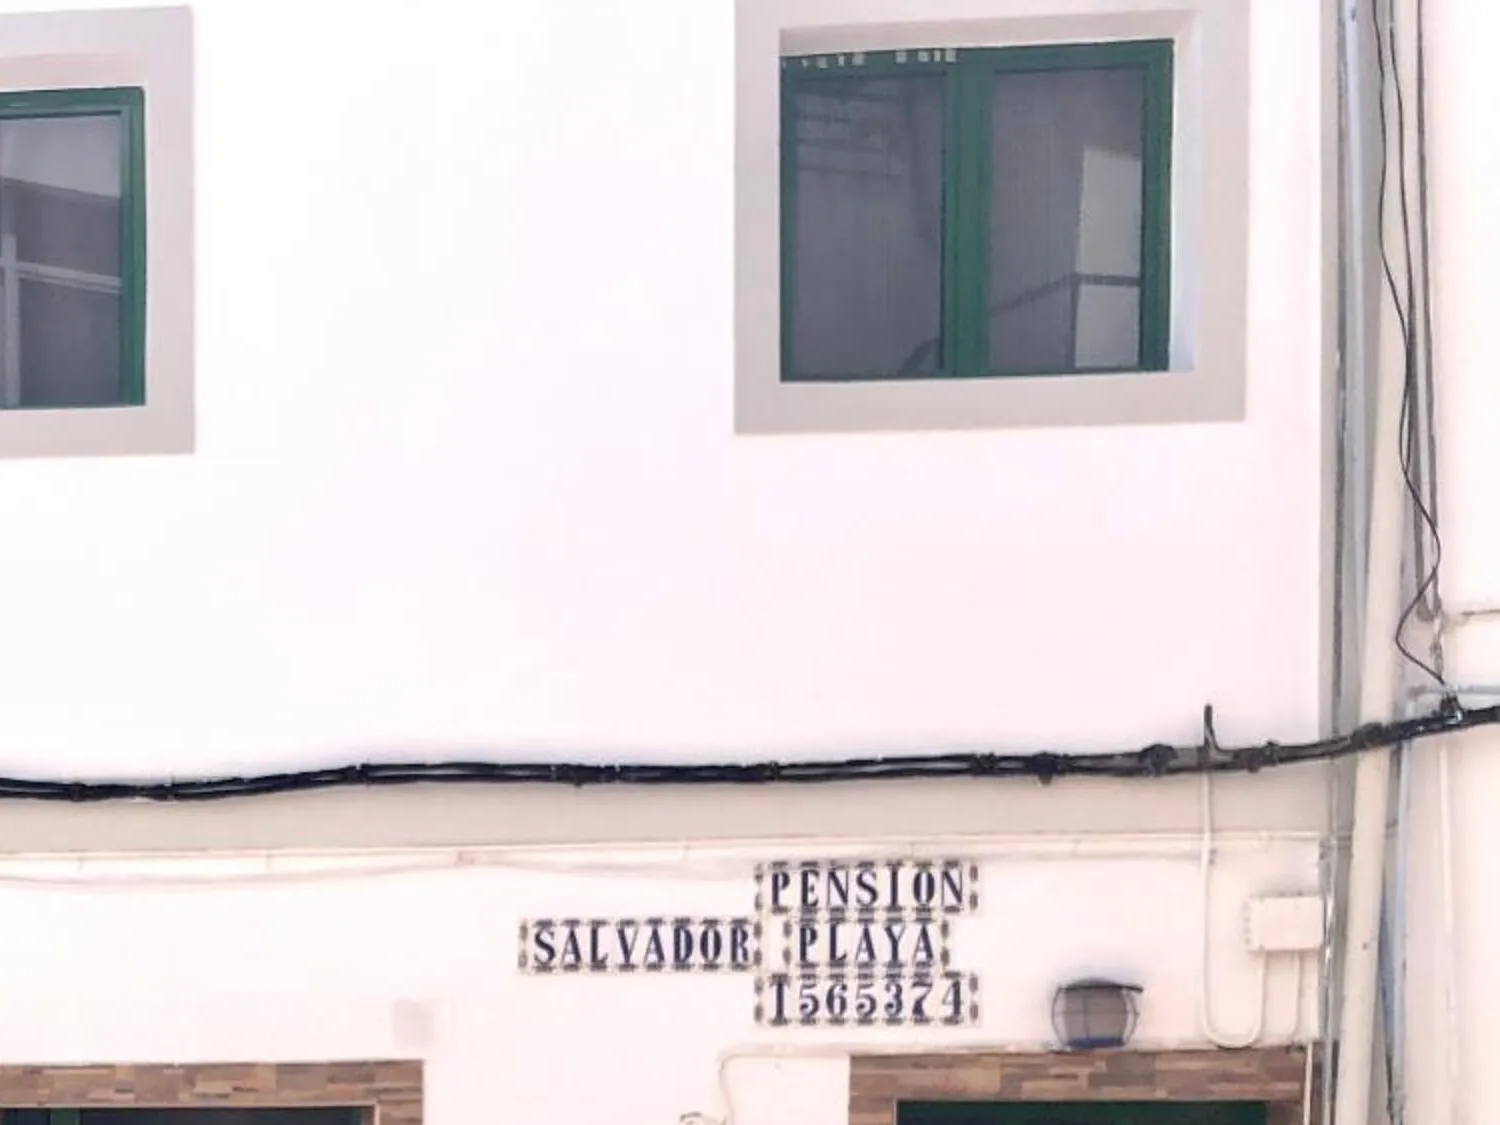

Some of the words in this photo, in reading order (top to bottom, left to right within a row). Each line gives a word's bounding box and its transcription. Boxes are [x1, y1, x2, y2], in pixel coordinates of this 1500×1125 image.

[770, 866, 964, 908] PENSION
[532, 922, 750, 965] SALVADOR
[799, 920, 935, 963] PLAYA
